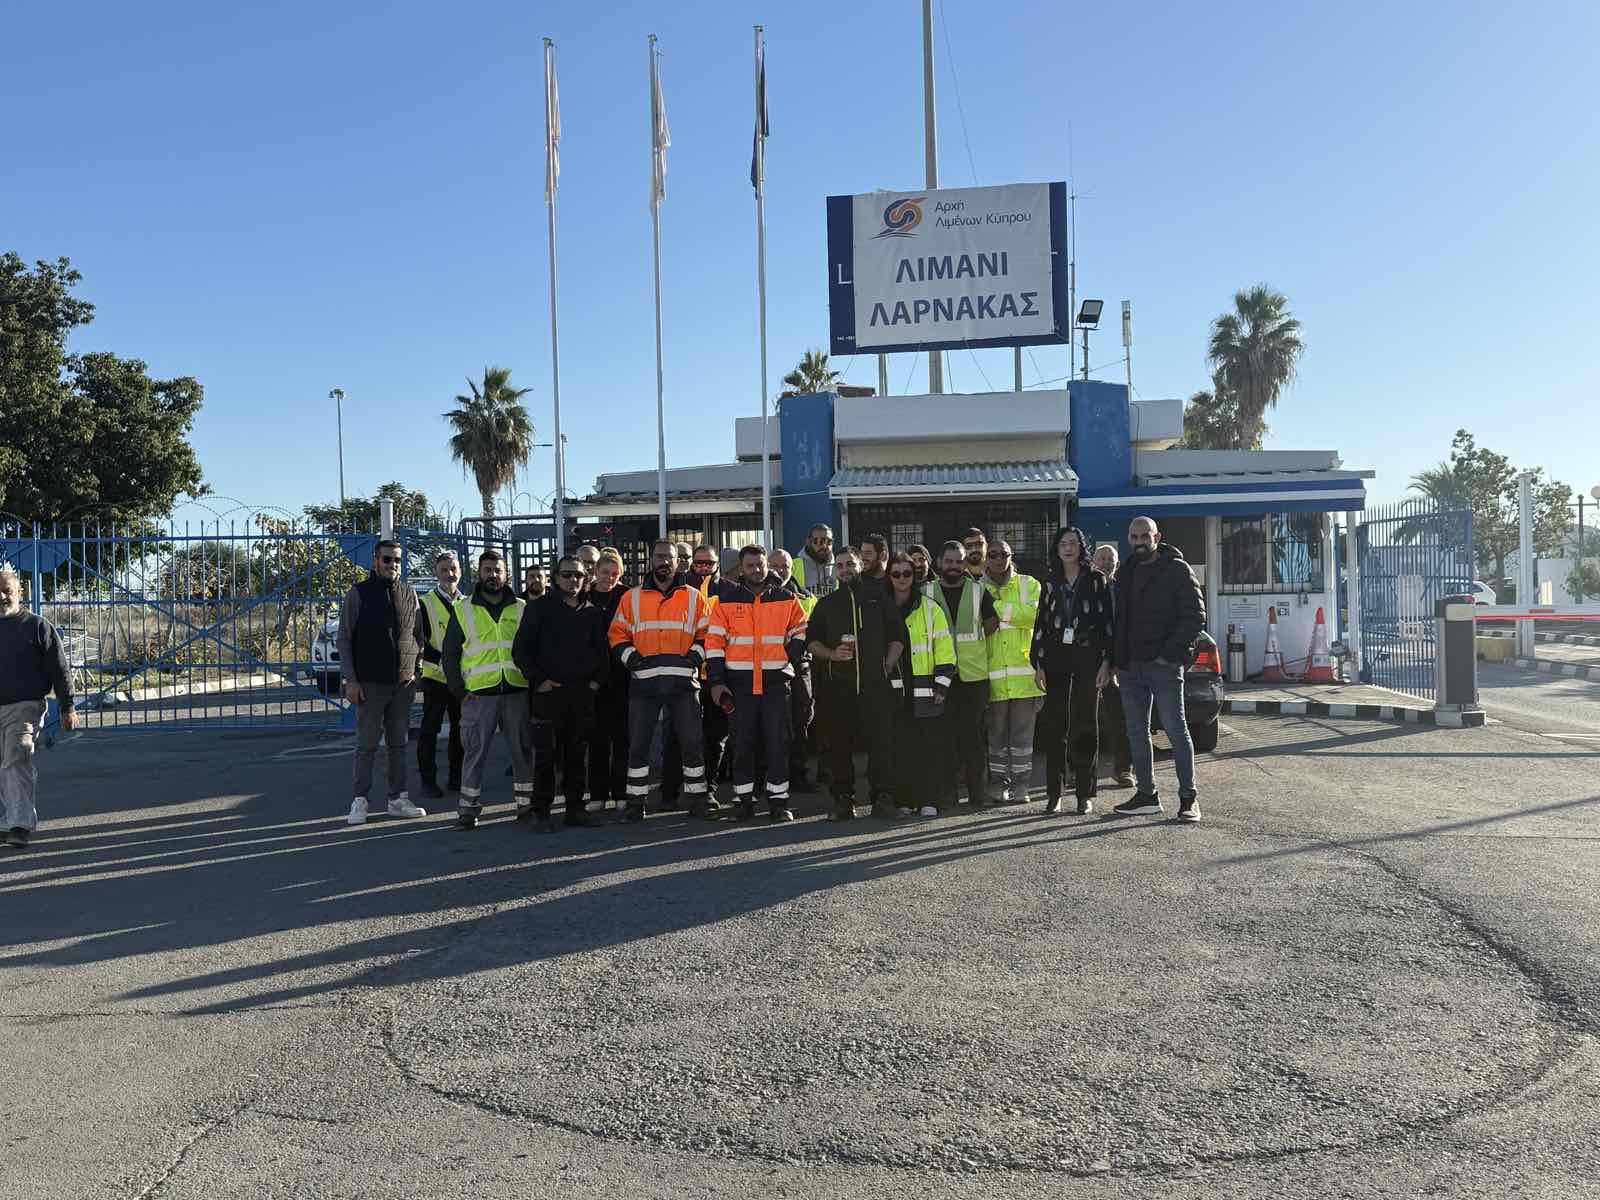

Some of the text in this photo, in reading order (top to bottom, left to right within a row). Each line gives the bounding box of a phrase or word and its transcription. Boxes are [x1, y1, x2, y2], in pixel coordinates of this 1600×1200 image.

[935, 200, 966, 214] Αρχή
[935, 211, 1032, 230] Λιμένων Κύπρου
[895, 251, 1008, 283] ΛΙΜΑΝΙ
[869, 291, 1040, 327] ΛΑΡΝΑΚΑΣ
